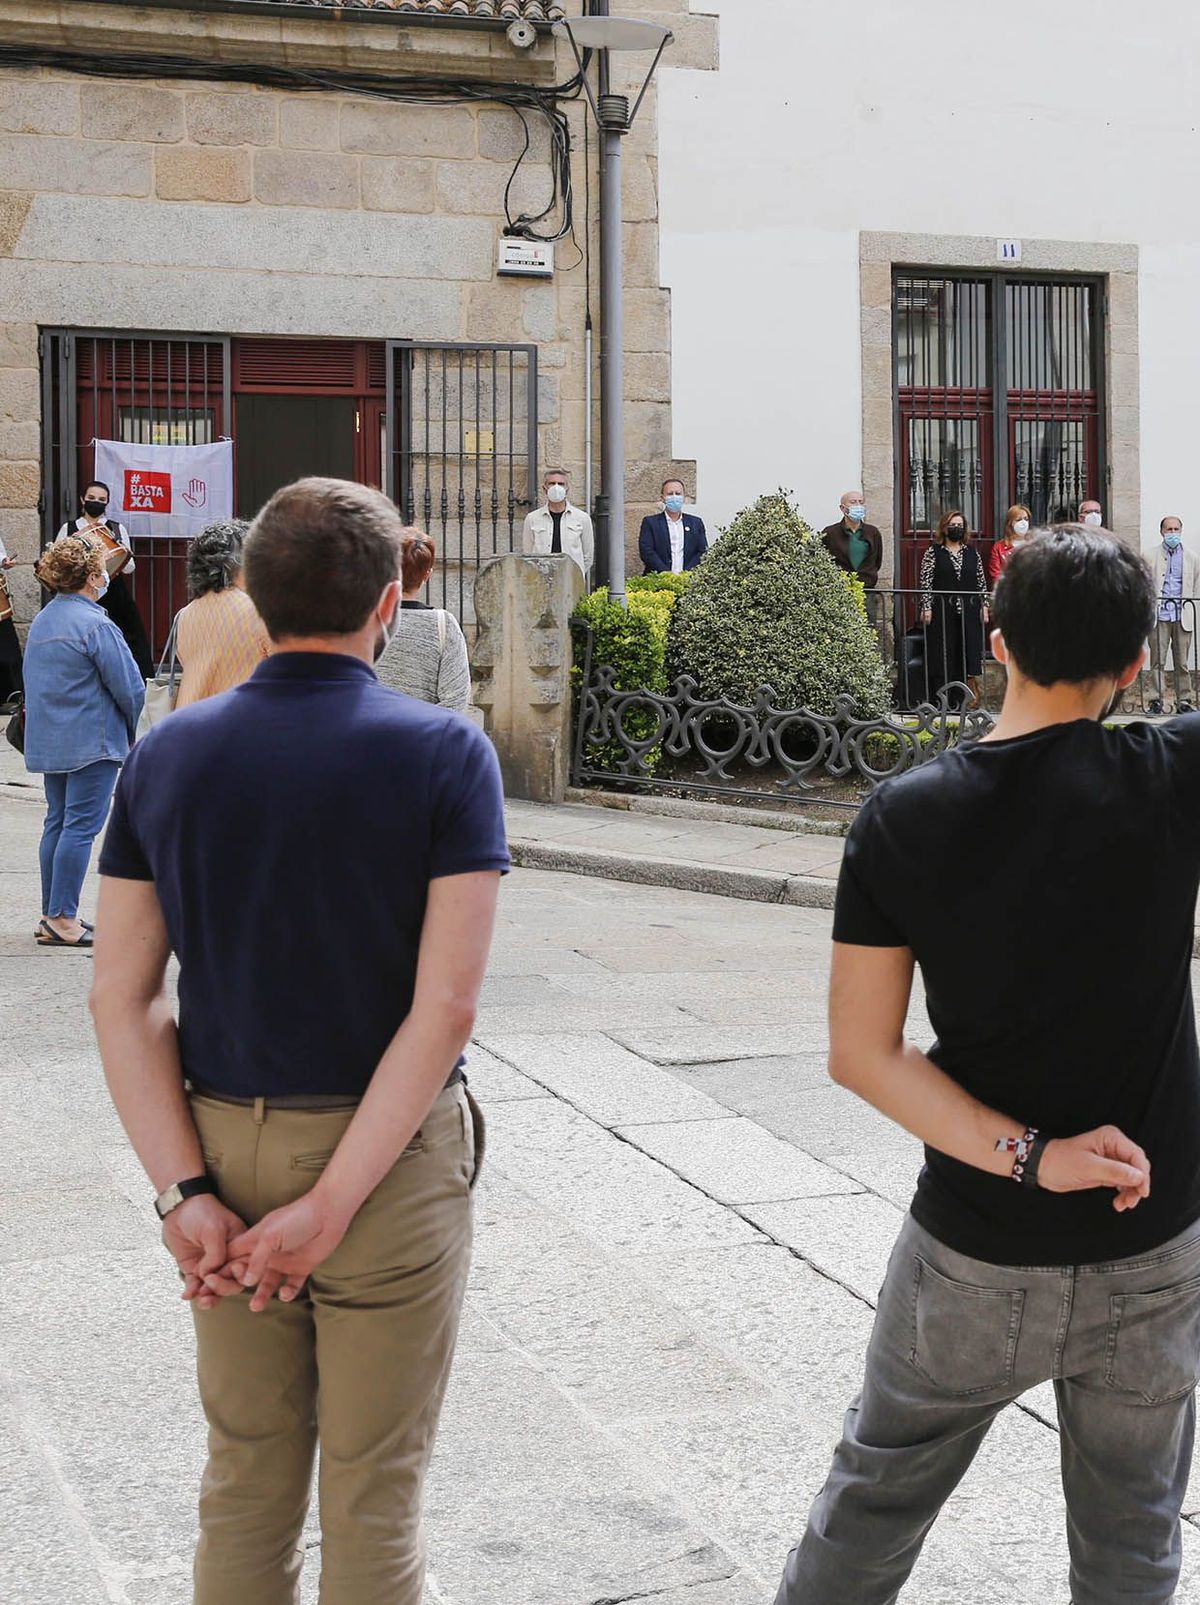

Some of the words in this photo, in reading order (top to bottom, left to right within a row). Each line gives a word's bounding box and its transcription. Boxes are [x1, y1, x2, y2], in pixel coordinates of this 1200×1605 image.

[1003, 244, 1015, 257] 11
[130, 474, 141, 485] #
[130, 484, 164, 497] BASTA
[130, 496, 154, 508] XA
